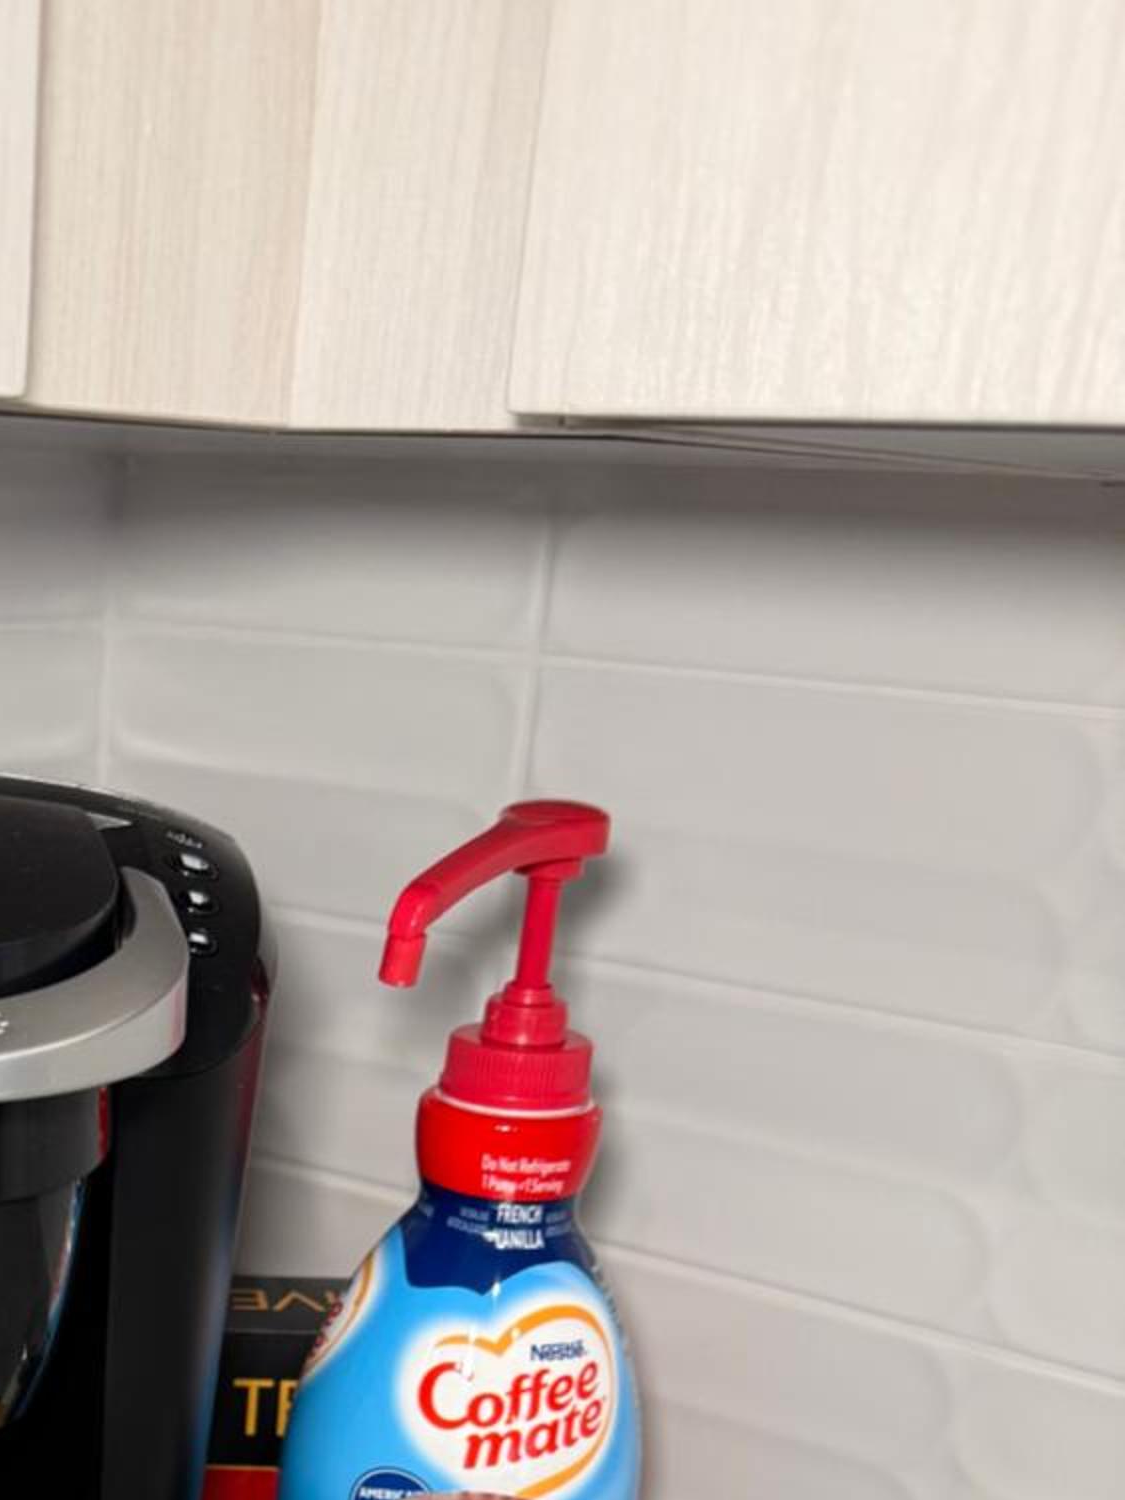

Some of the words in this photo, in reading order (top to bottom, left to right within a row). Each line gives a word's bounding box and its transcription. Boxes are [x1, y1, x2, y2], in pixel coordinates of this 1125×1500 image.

[496, 1203, 543, 1222] FRENCH
[418, 1361, 598, 1430] Coffee
[463, 1400, 603, 1469] mate
